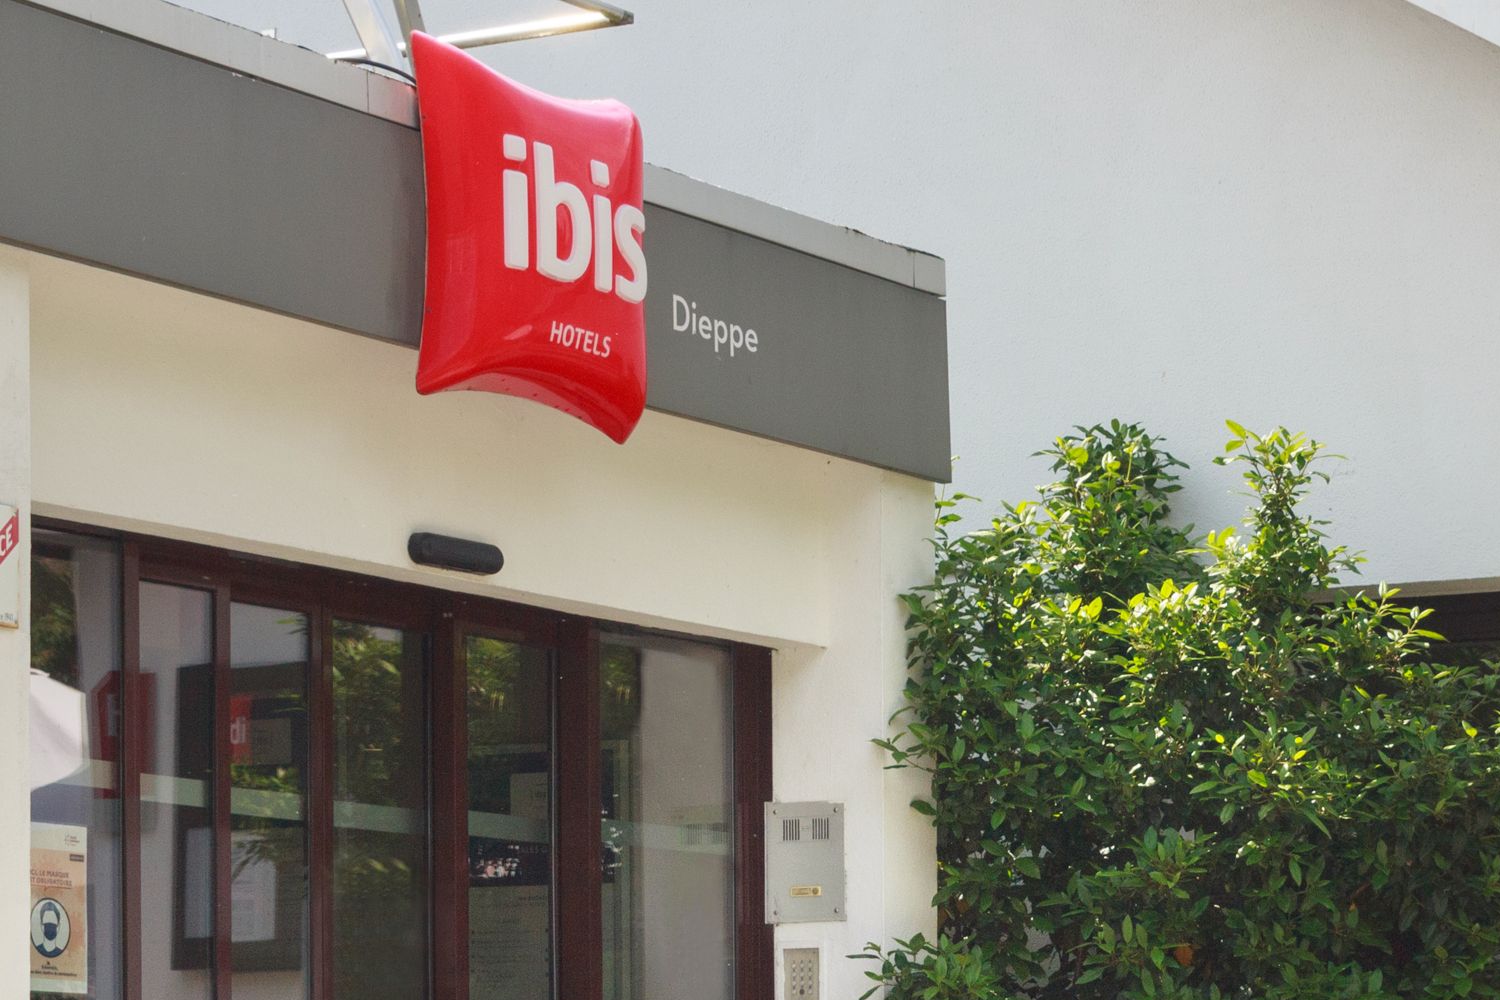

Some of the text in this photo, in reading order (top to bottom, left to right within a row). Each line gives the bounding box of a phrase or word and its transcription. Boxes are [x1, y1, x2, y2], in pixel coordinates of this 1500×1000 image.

[502, 133, 648, 305] ibis
[549, 320, 612, 358] HOTELS
[672, 294, 759, 358] Dieppe
